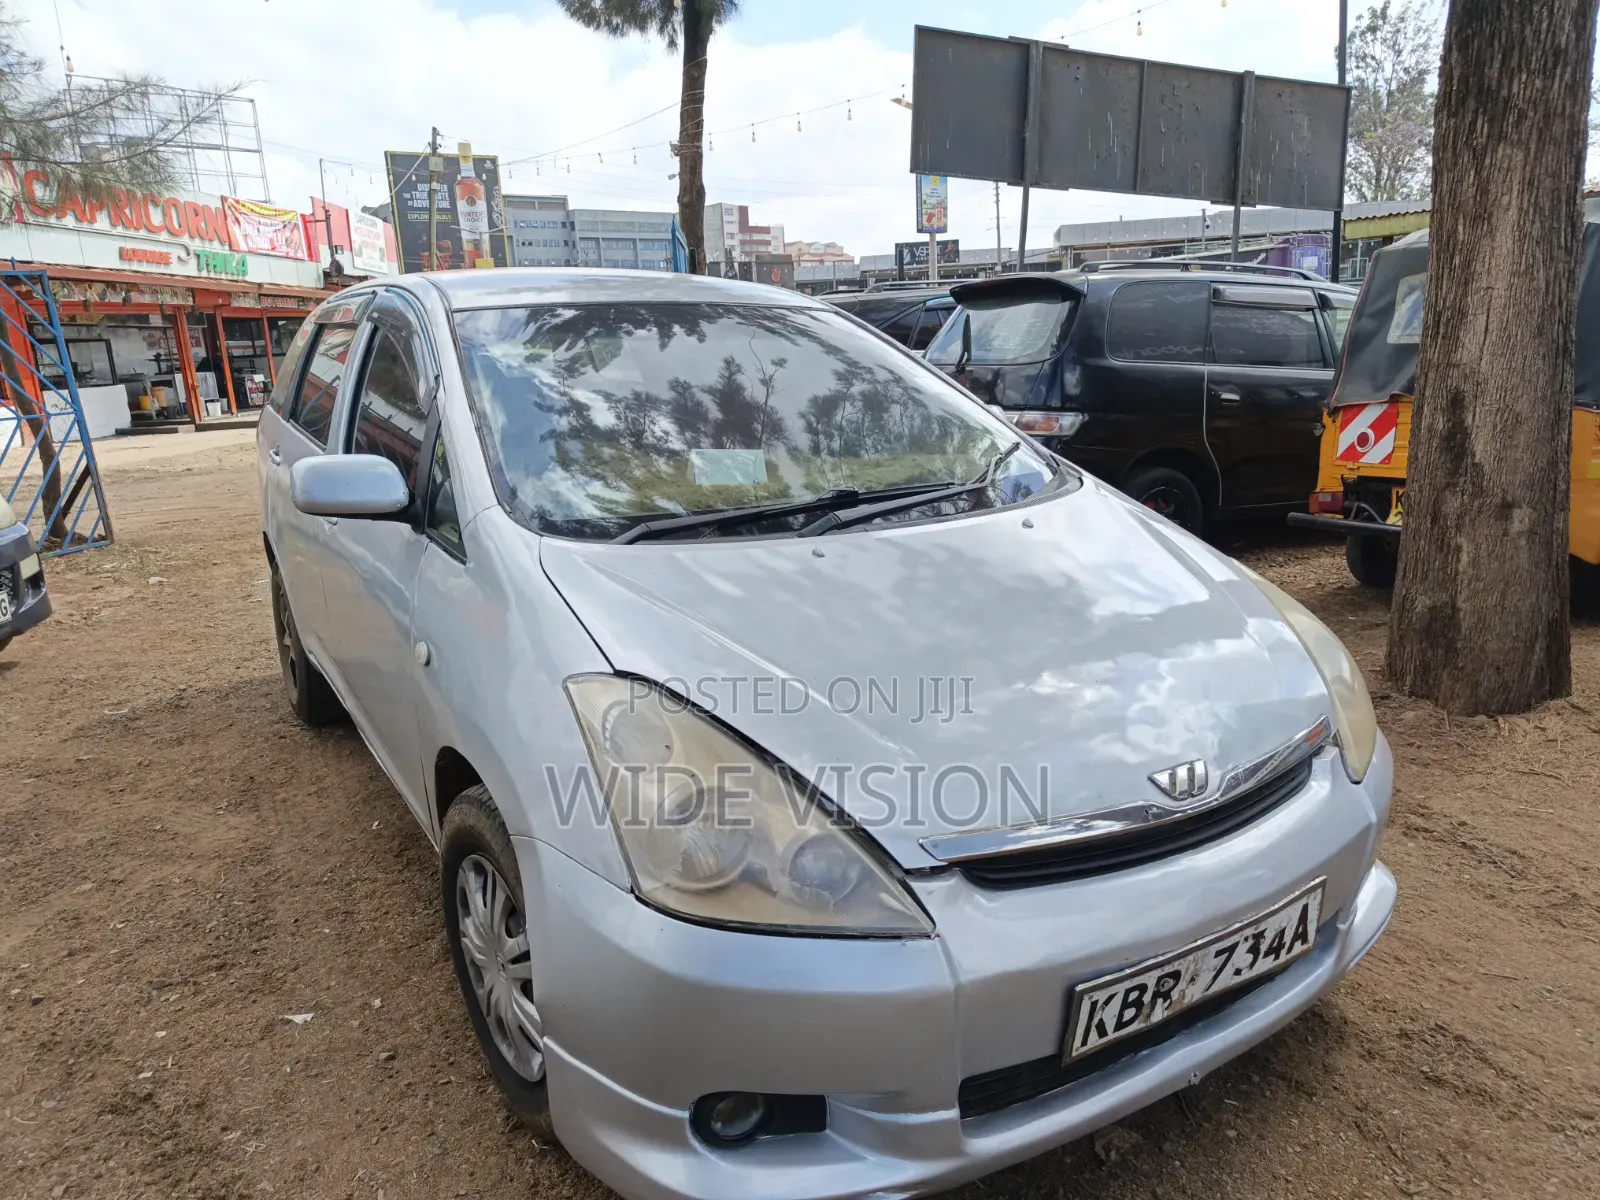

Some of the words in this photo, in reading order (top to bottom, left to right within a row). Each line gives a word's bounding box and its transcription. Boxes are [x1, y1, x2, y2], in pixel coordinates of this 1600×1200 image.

[412, 191, 429, 200] TRUE
[417, 183, 449, 192] DISER
[24, 169, 228, 246] CAPRICORN
[119, 246, 173, 265] LOUNGE
[194, 249, 249, 276] THIKA
[0, 596, 8, 620] G
[1202, 901, 1310, 993] 734A
